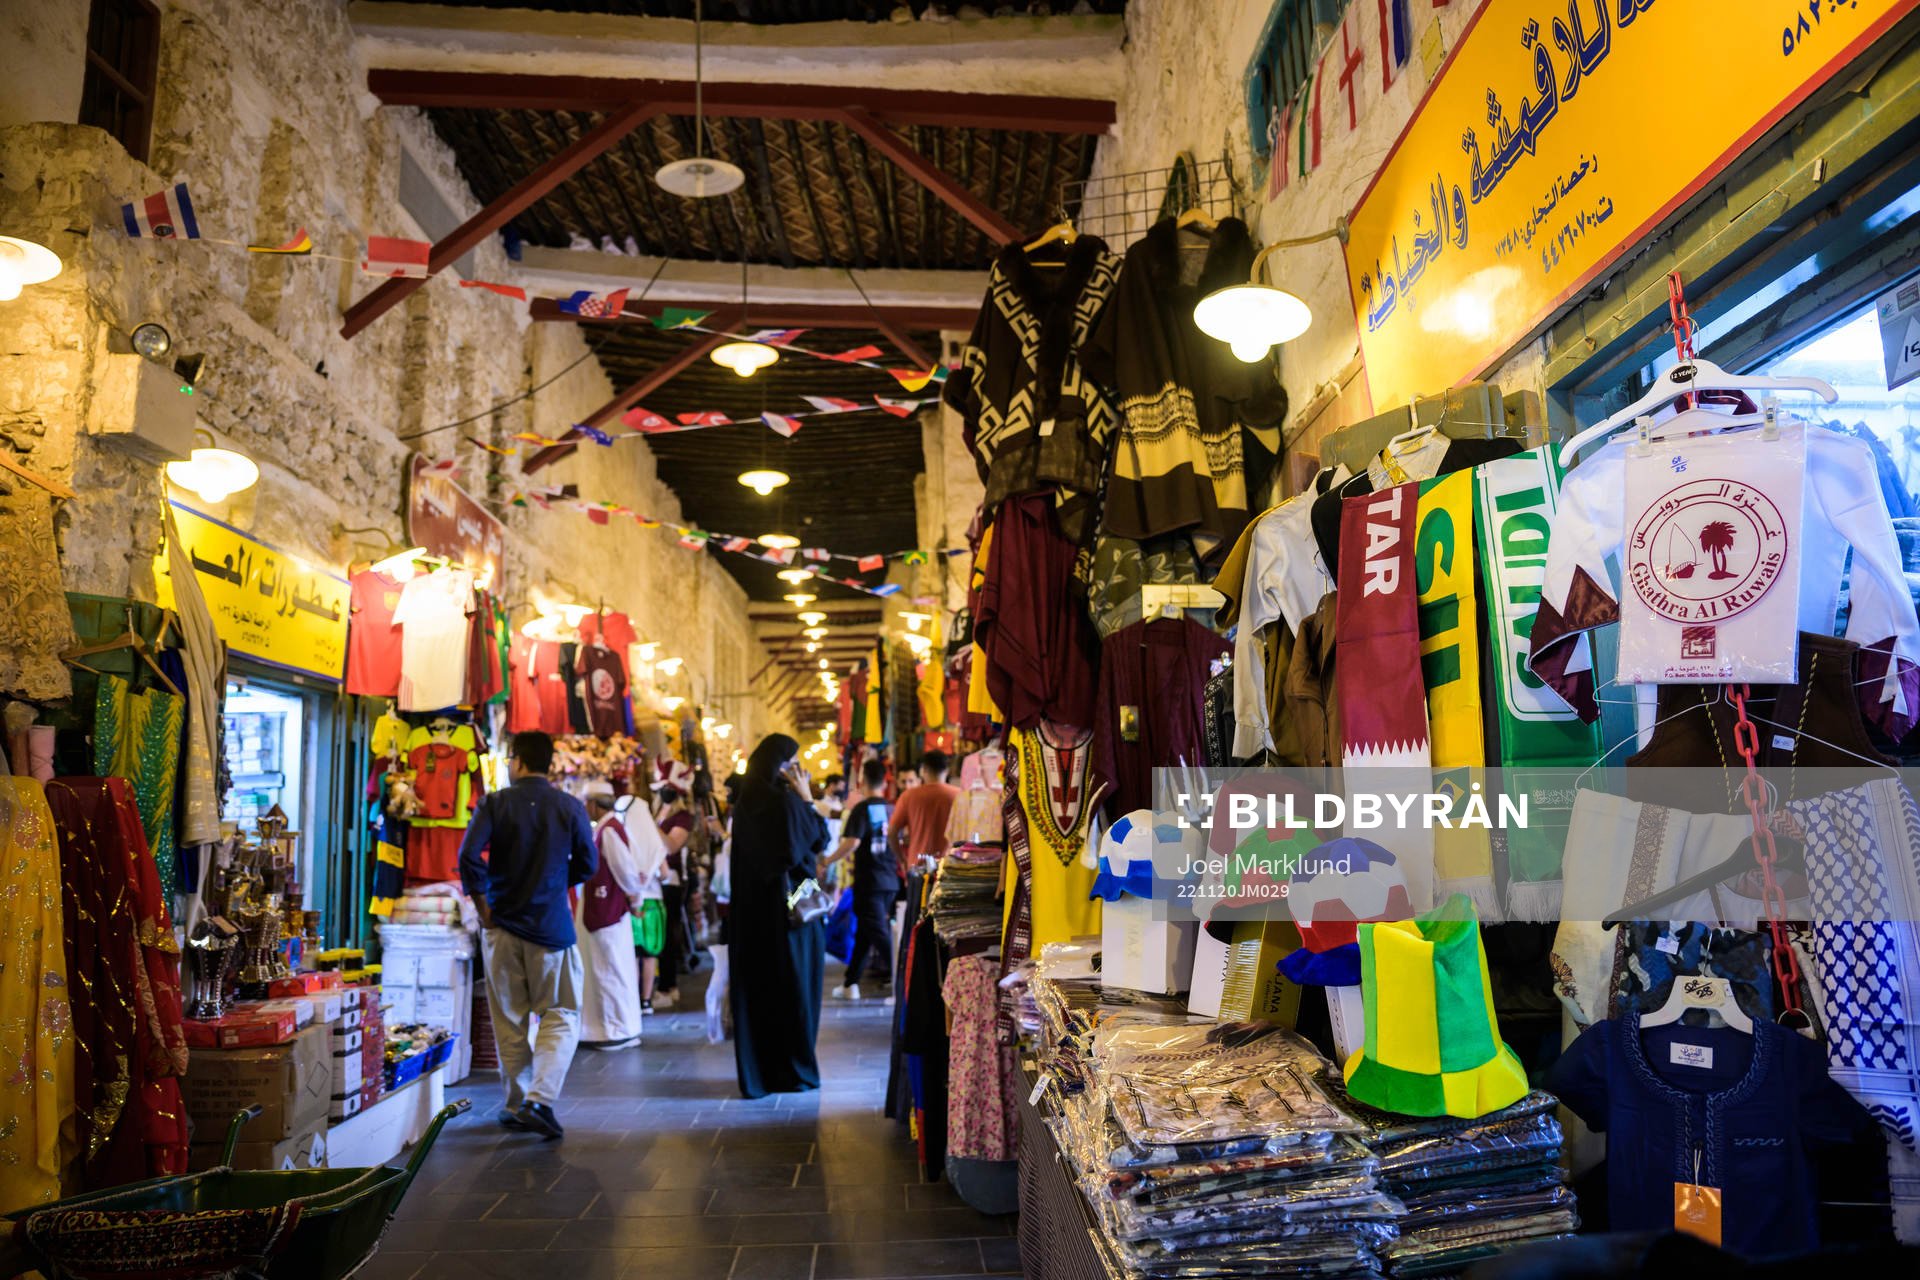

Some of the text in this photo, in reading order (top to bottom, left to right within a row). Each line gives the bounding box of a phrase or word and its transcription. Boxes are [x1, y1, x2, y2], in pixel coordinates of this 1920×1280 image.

[1559, 153, 1598, 198] رخصة
[1361, 172, 1468, 332] والخياطة
[1364, 487, 1402, 598] TAR
[1633, 552, 1781, 619] Ghathra Al Ruwais
